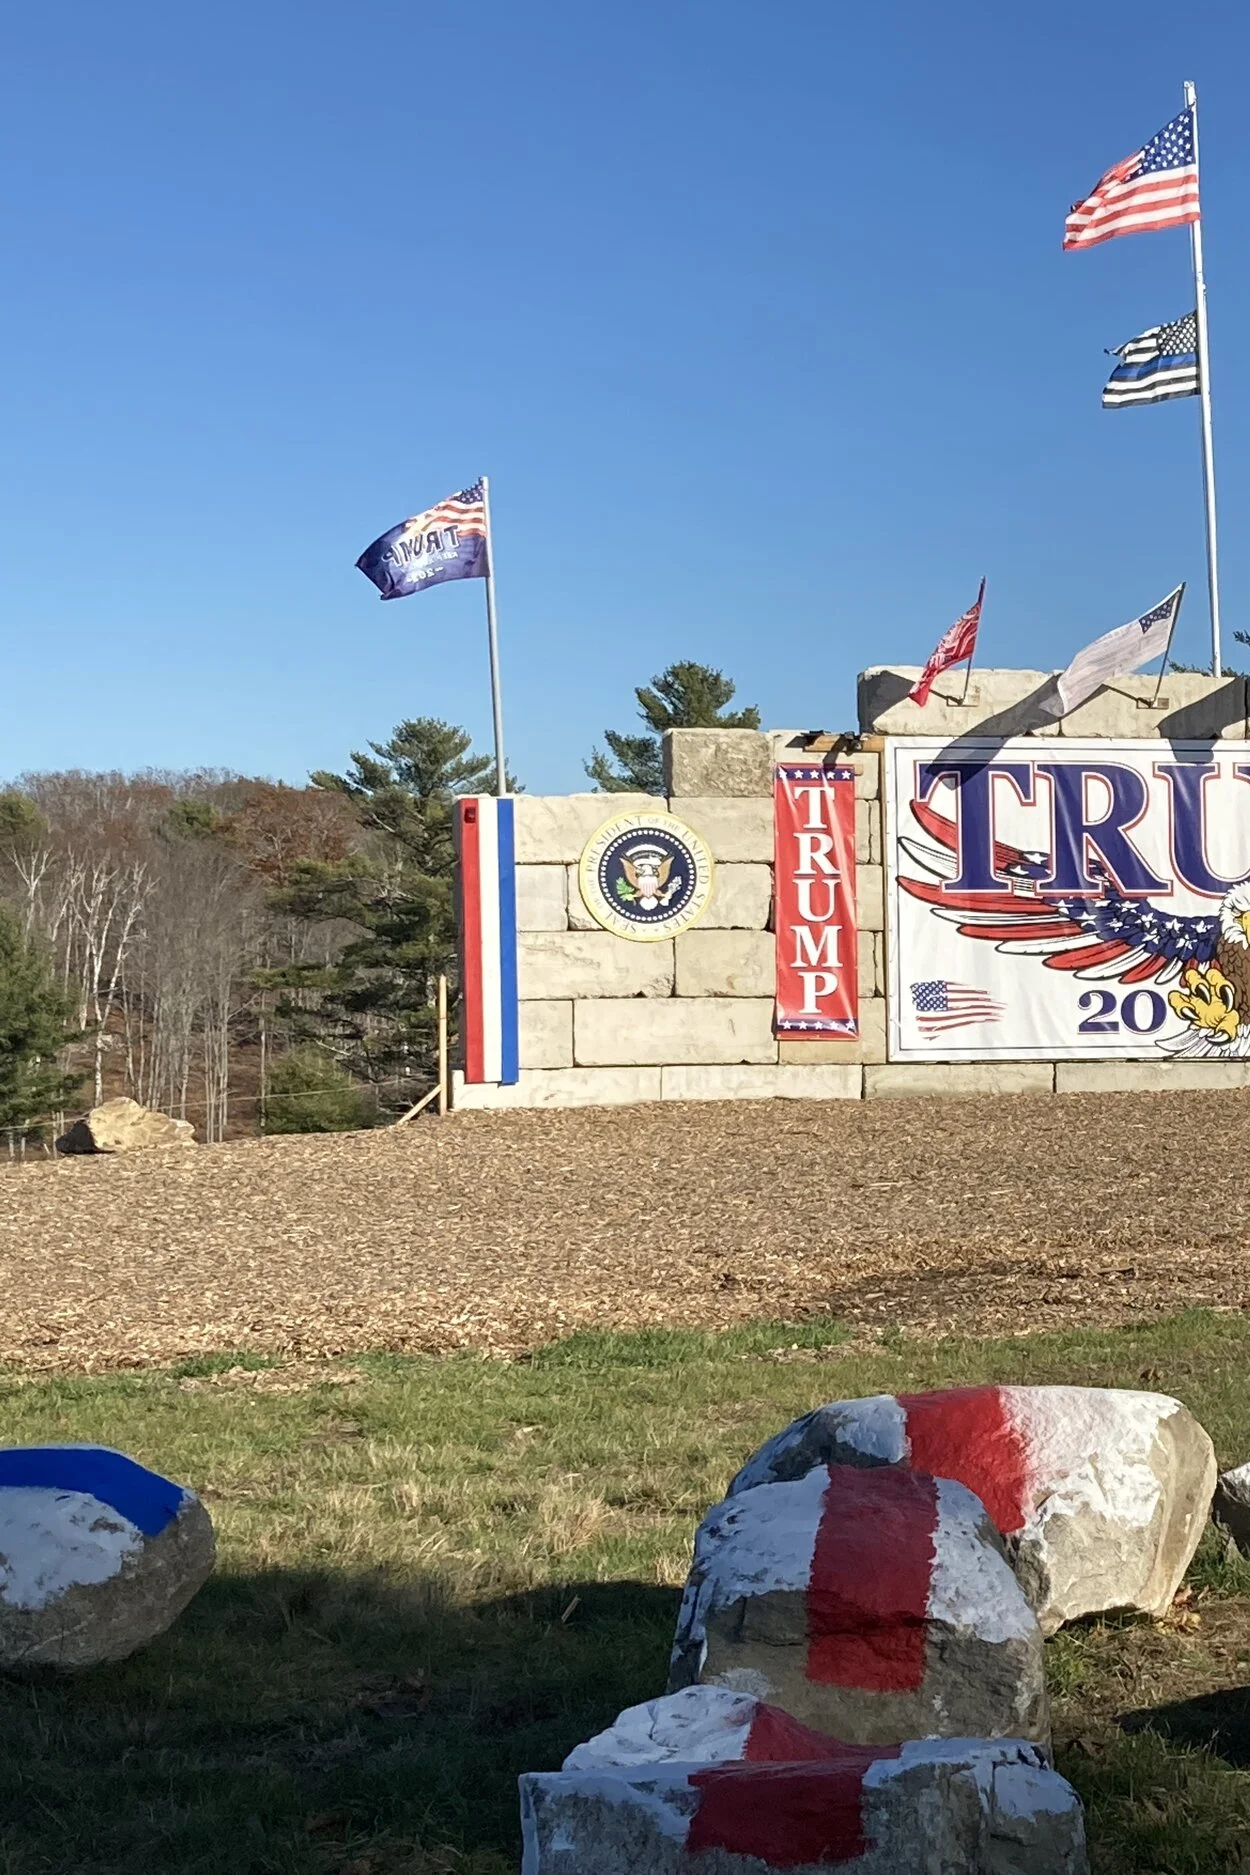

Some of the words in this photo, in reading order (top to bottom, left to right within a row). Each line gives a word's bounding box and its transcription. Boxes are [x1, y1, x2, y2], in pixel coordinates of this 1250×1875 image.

[585, 815, 643, 872] PRESIDENT
[682, 831, 710, 885] UNITED
[663, 892, 704, 933] STATES
[790, 786, 843, 1015] TRUMP
[1077, 989, 1167, 1035] 20
